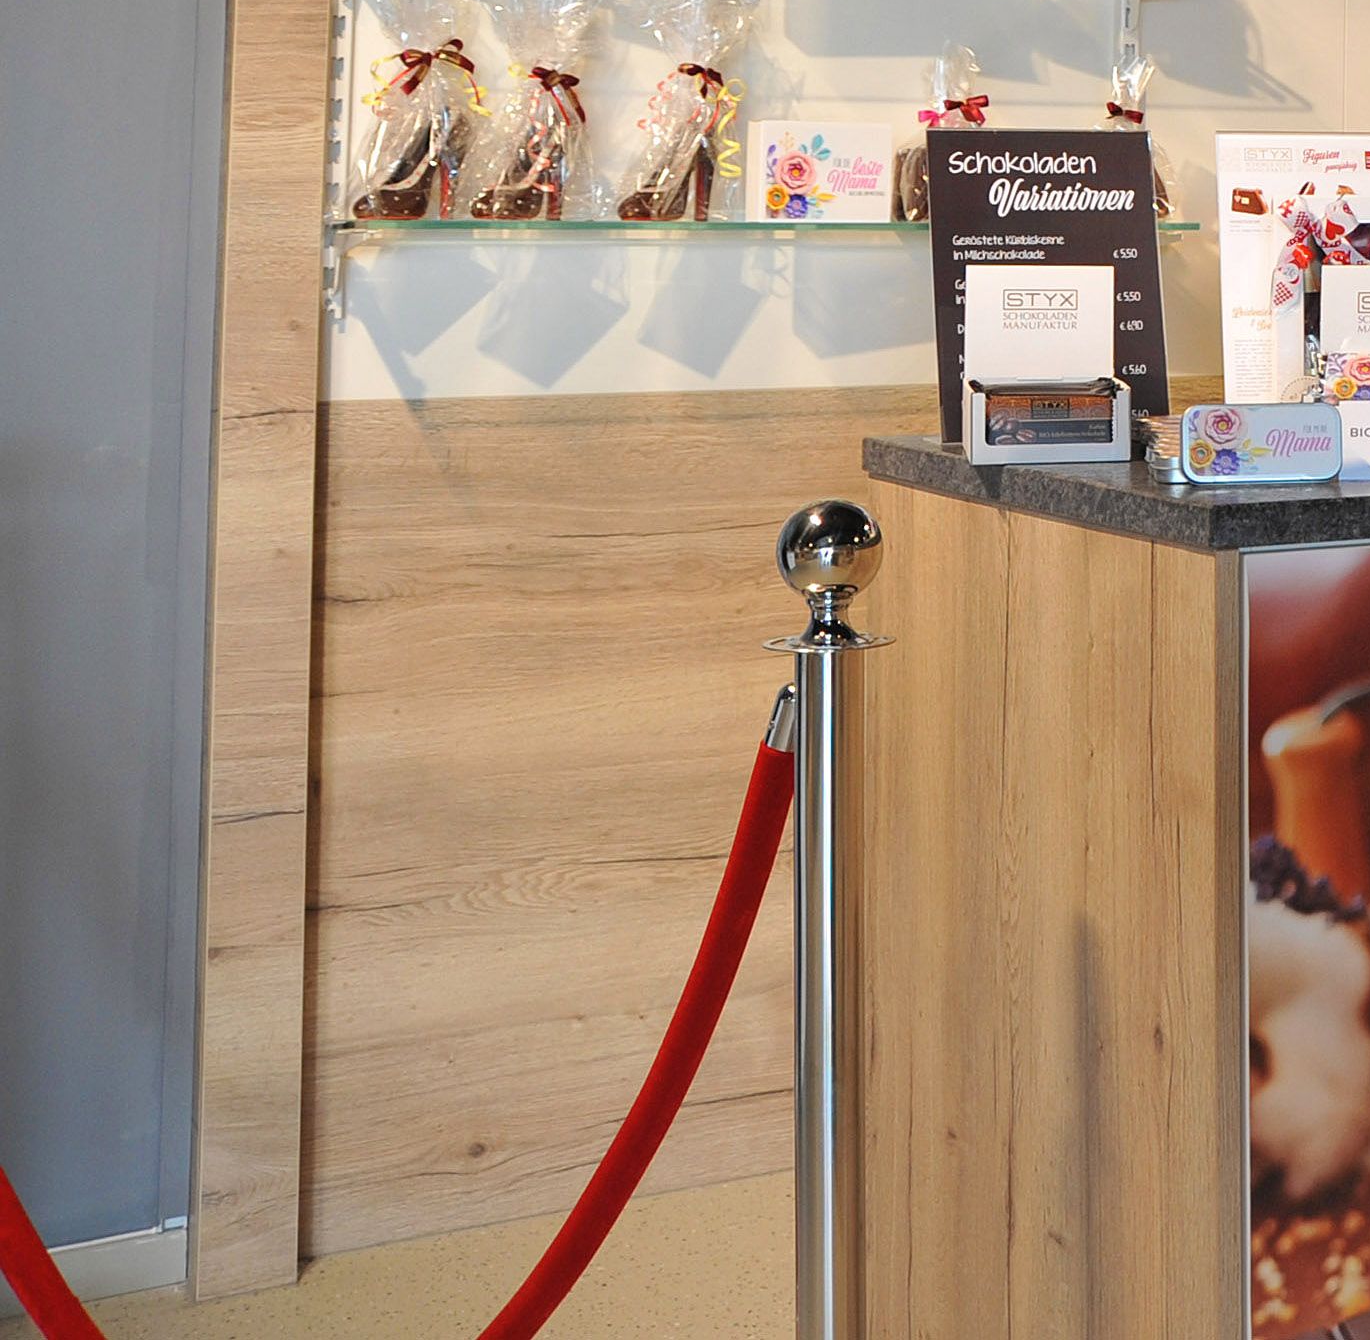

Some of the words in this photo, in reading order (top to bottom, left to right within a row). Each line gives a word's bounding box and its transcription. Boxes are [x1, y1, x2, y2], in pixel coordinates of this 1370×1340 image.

[948, 151, 1097, 175] Schokoladen
[1246, 149, 1290, 159] STYX
[827, 168, 878, 193] Mama
[988, 178, 1135, 218] Variationen
[1006, 292, 1075, 307] STYX
[1002, 312, 1078, 321] SCHOKOLADEN
[1002, 321, 1078, 330] MANUFAKTUR
[1265, 428, 1332, 458] Mama
